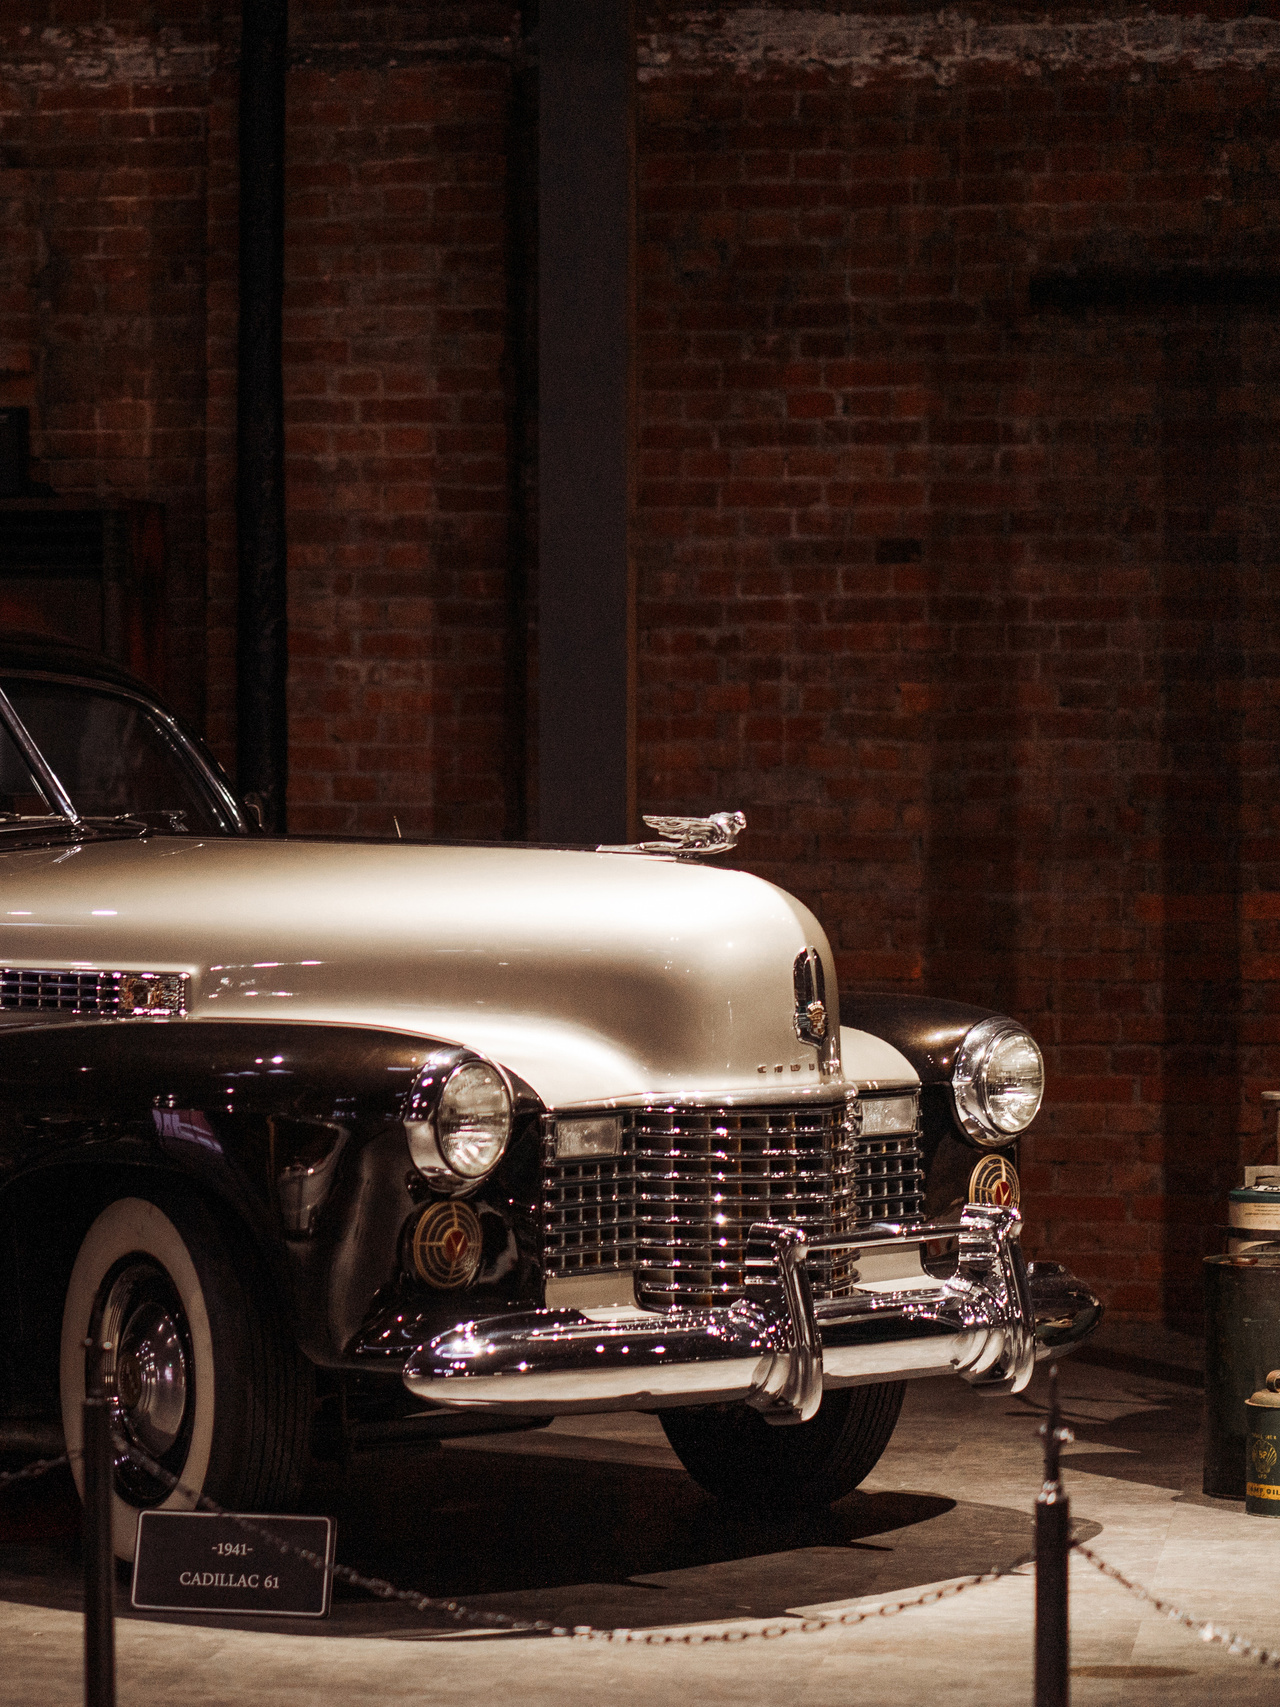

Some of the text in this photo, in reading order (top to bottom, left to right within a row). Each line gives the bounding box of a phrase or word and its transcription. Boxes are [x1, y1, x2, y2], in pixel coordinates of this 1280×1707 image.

[211, 1542, 254, 1556] -1941-
[179, 1571, 280, 1589] CADILLAC 61
